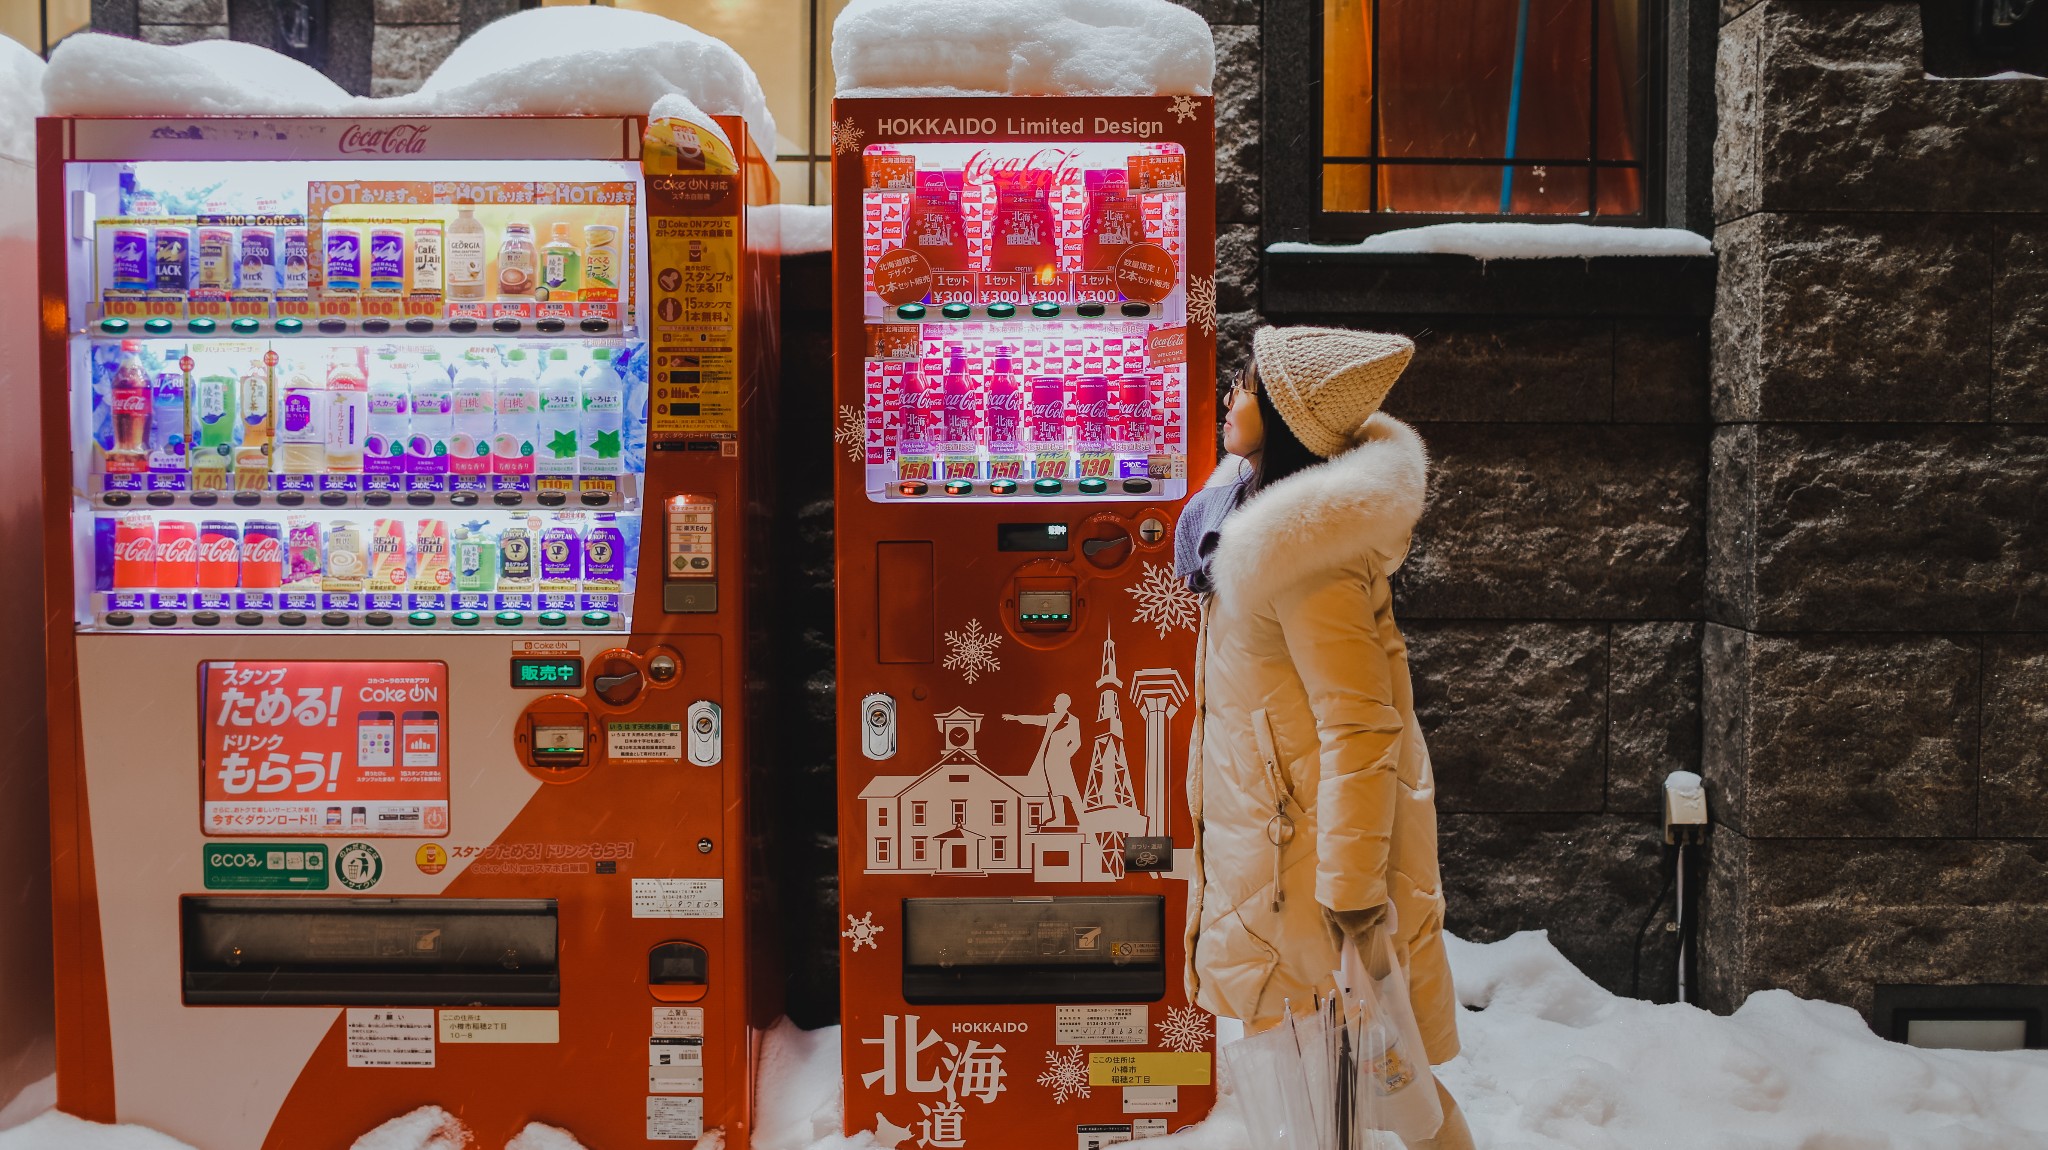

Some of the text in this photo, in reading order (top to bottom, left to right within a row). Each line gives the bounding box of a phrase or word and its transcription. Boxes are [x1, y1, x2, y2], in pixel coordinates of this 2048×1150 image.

[878, 117, 1163, 138] HOKKAIDO Limited Design
[653, 179, 686, 191] Coke
[711, 181, 728, 190] 対応
[257, 216, 297, 225] Coffee
[668, 220, 688, 228] Coke
[879, 255, 918, 271] 北海道限定
[685, 272, 733, 282] スタンプが
[888, 266, 914, 279] デザイン
[937, 275, 969, 286] 1セット
[984, 275, 1016, 285] 1セット
[1032, 275, 1063, 286] 1セット
[1082, 274, 1112, 285] 1セット
[1118, 269, 1170, 289] 2本セット販売
[878, 275, 931, 296] 2本セット販売
[934, 291, 972, 303] ¥300
[981, 291, 1019, 303] ¥300
[1028, 291, 1067, 302] ¥300
[1077, 290, 1116, 301] ¥300
[1151, 334, 1184, 349] Coca-Cola
[460, 399, 479, 408] 白桃
[504, 399, 523, 408] 白桃
[222, 668, 287, 685] スタンプ
[521, 664, 574, 681] 販売中
[359, 687, 406, 702] Coke
[216, 686, 342, 727] ためる!
[223, 734, 284, 751] ドリンク
[218, 752, 342, 794] もらう!
[339, 843, 379, 859] のんだあとは
[452, 843, 634, 859] スタンプためる! ドリンクもらう!
[471, 864, 501, 874] Coke
[341, 878, 377, 890] リサイクル
[952, 1022, 1028, 1033] HOKKAIDO
[1112, 1076, 1151, 1084] 稲穂2丁目
